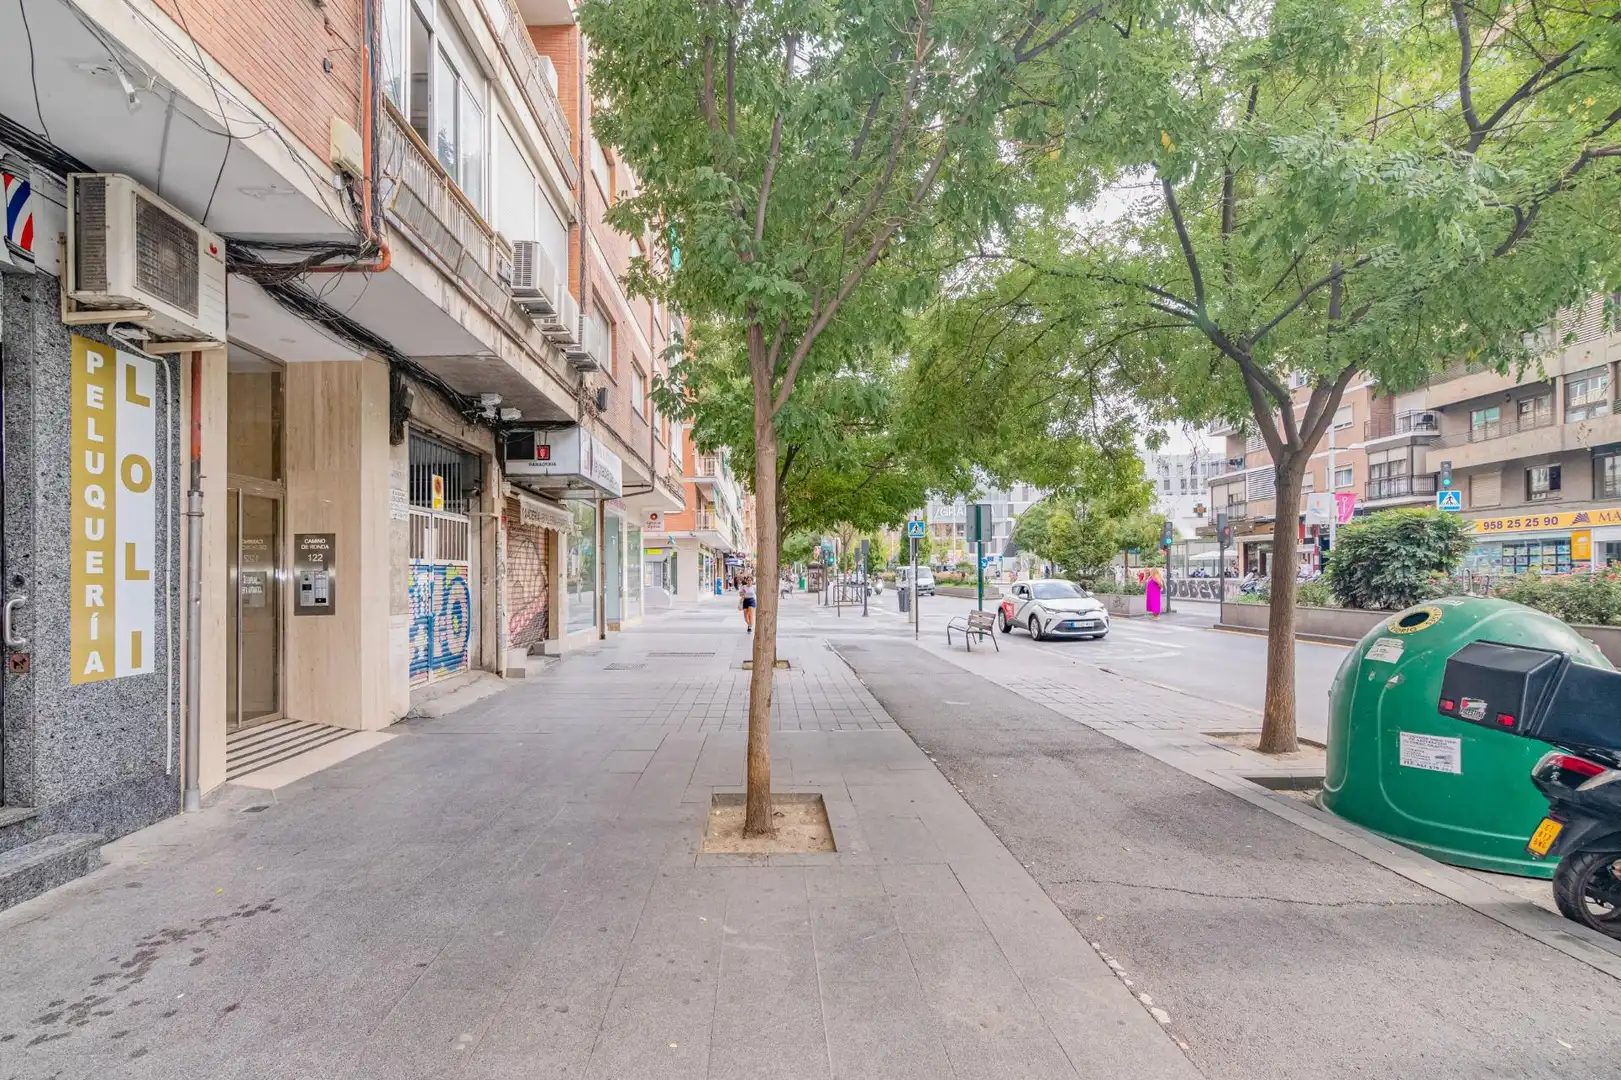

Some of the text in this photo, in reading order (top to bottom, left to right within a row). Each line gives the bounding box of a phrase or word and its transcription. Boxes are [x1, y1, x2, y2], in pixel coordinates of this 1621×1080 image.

[84, 350, 105, 675] PELUQUERÍA
[121, 364, 153, 669] LOLI
[307, 553, 323, 562] 122
[1483, 520, 1503, 530] 958
[1507, 519, 1521, 529] 25
[1525, 517, 1539, 527] 25
[1544, 516, 1559, 526] 90
